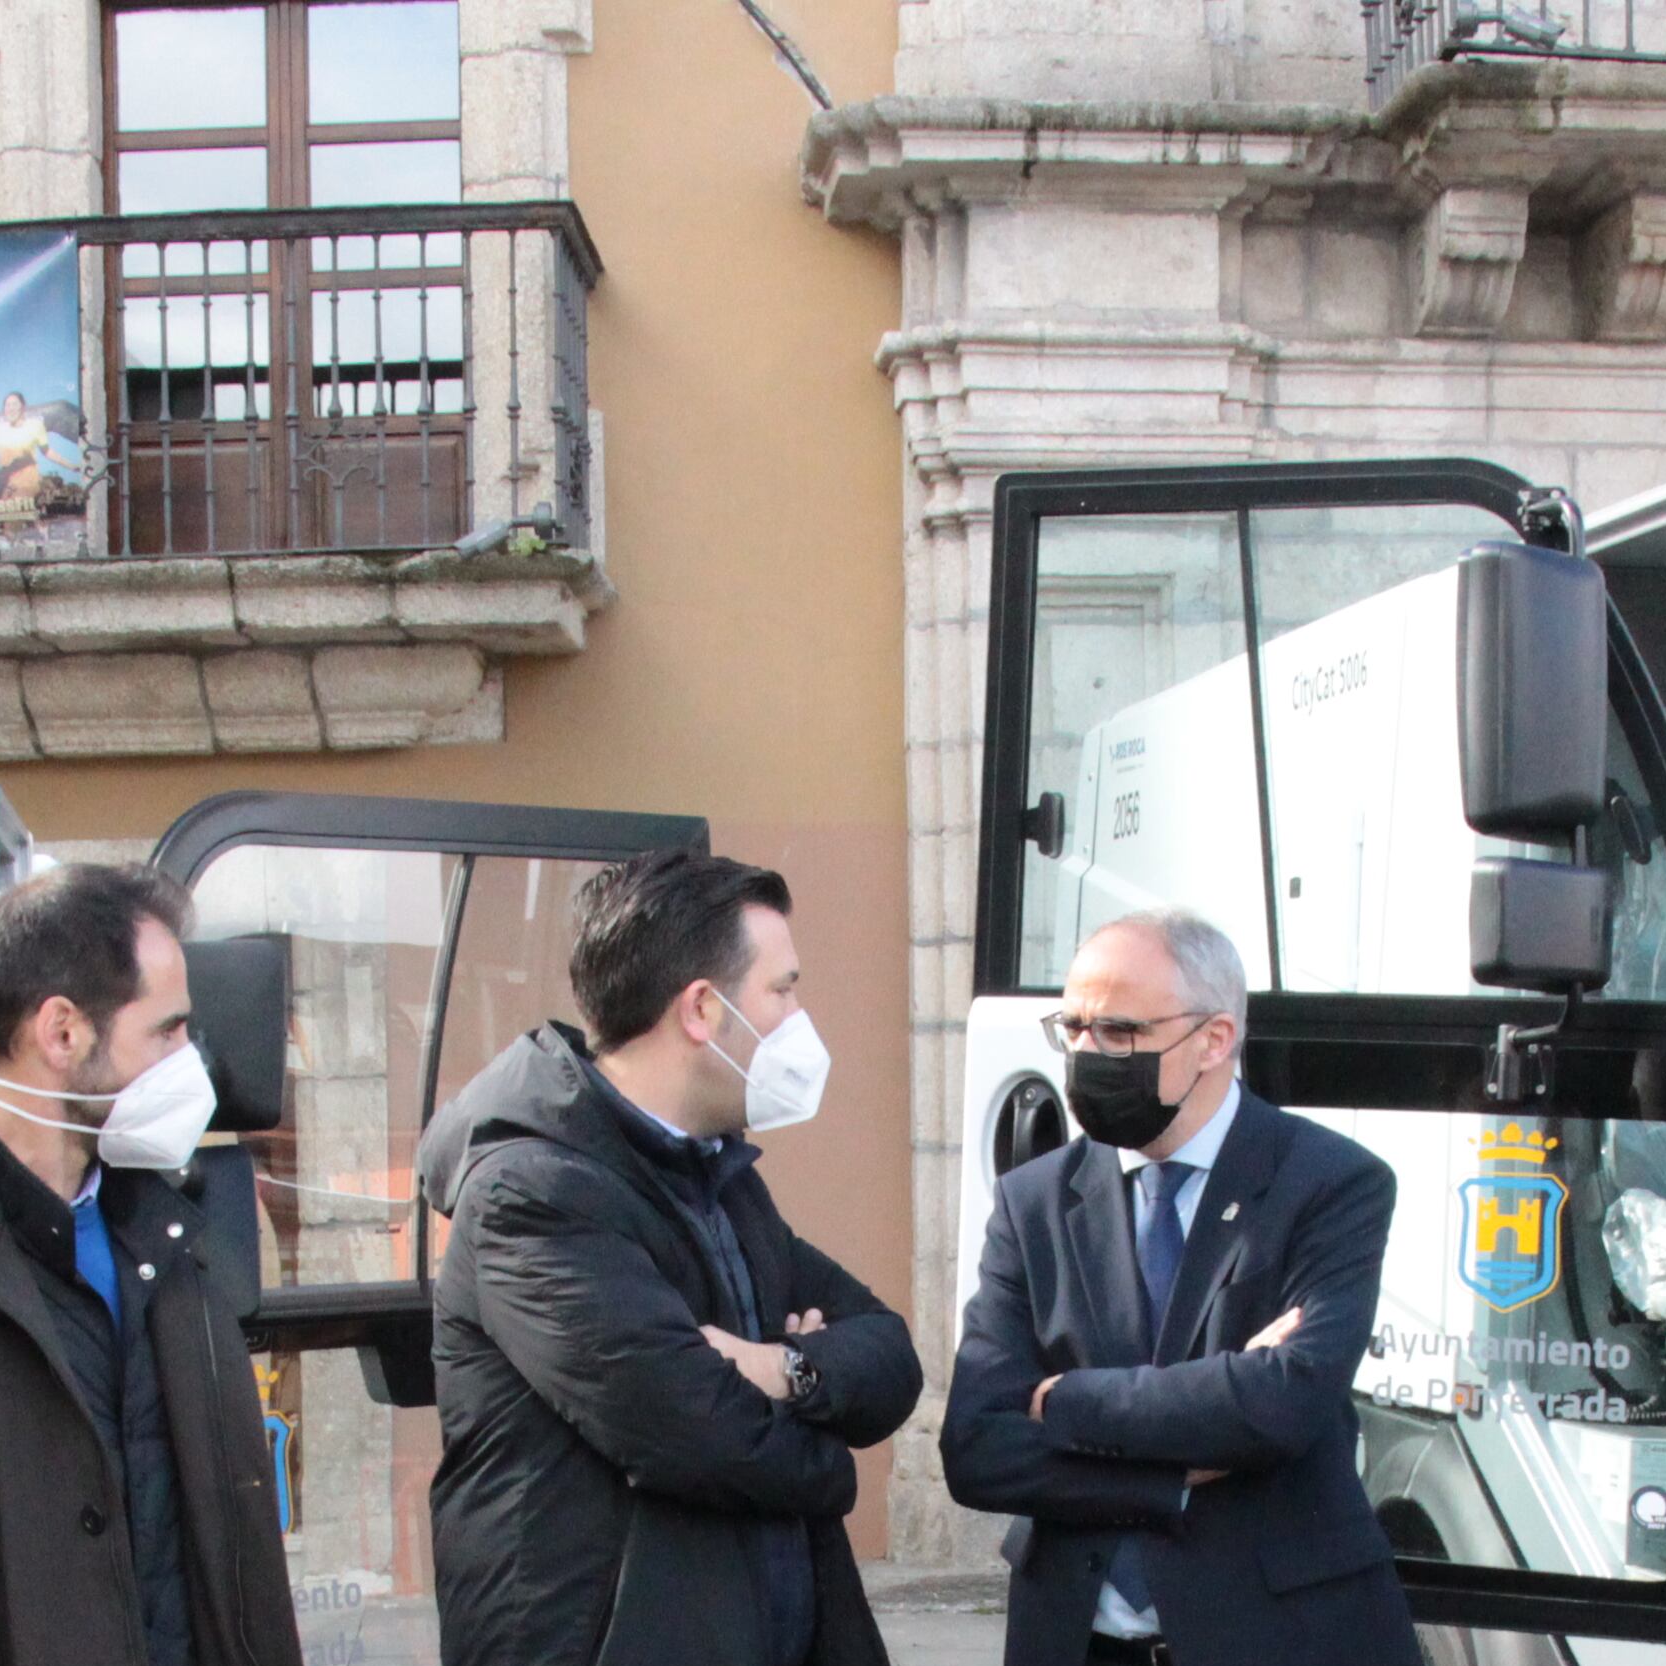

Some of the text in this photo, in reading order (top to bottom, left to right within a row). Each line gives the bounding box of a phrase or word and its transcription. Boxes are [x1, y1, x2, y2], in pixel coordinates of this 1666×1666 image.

[1339, 650, 1368, 694] 5006
[1113, 790, 1140, 840] 2056
[1375, 1323, 1631, 1370] Ayuntamiento
[1372, 1374, 1629, 1424] de Ponferrada
